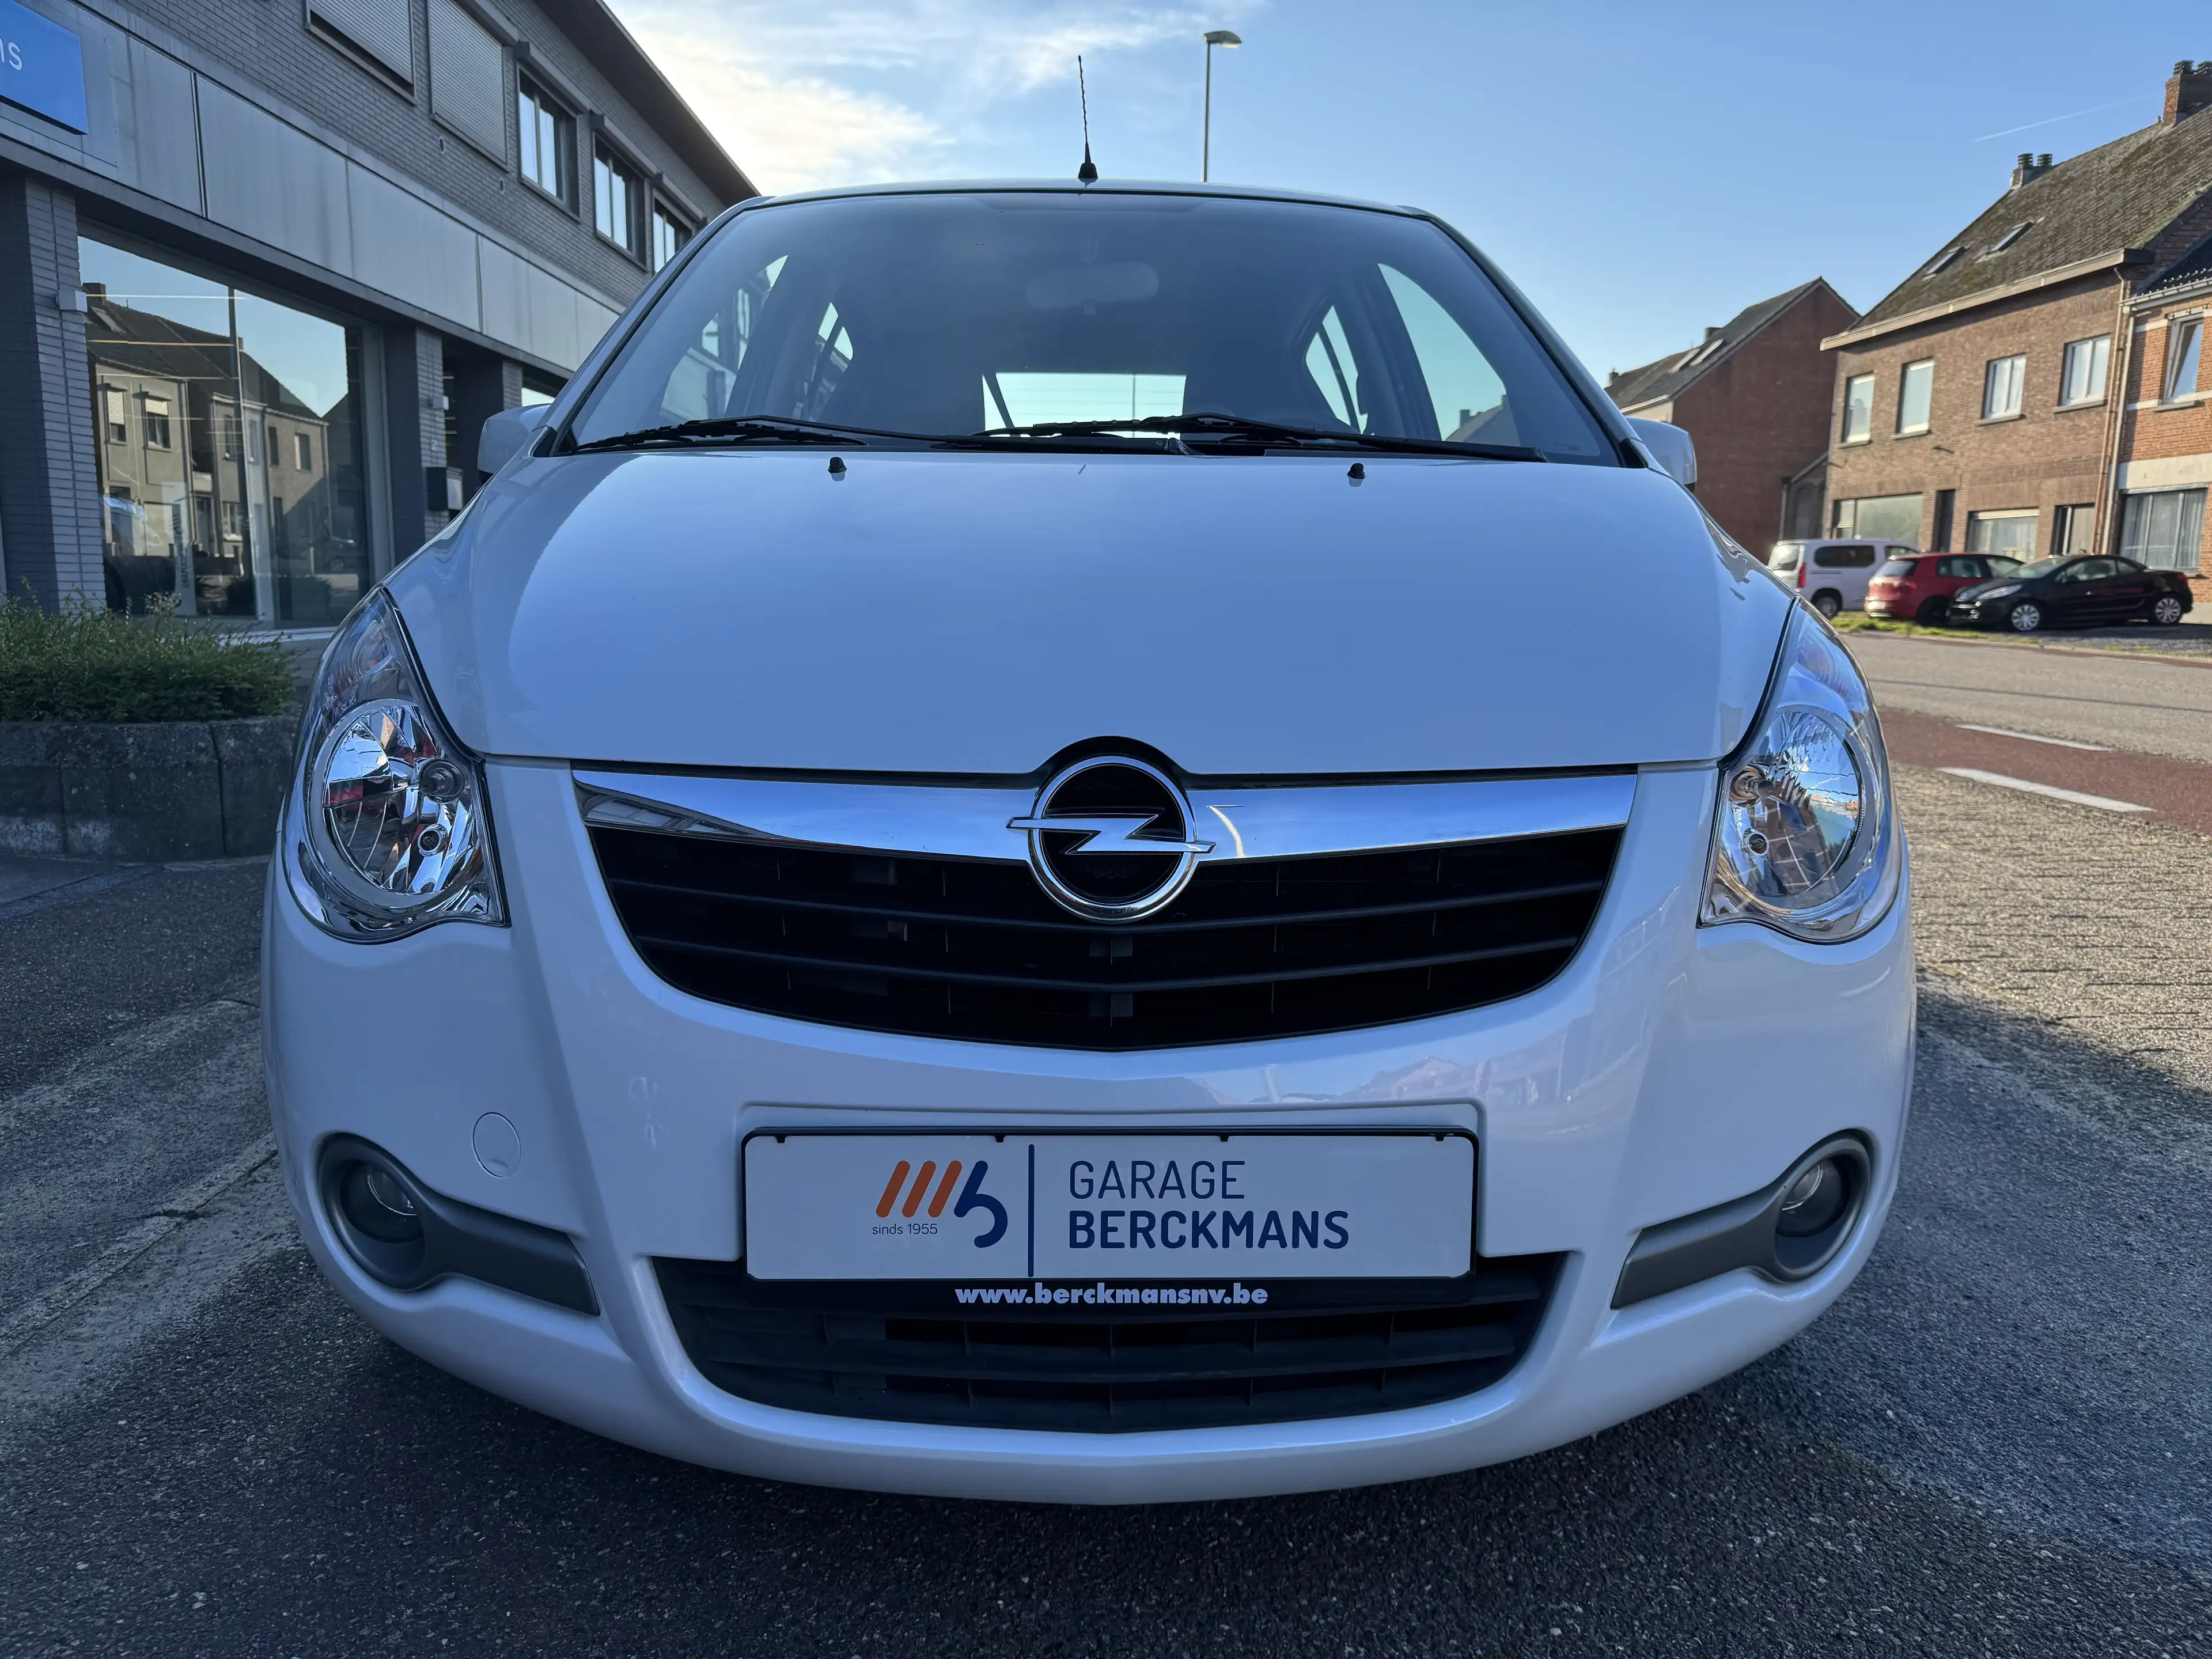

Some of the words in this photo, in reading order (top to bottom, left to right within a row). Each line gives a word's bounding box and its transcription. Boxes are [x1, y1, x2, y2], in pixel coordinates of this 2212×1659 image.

[1070, 1160, 1245, 1199] GARAGE
[872, 1223, 903, 1235] sinds
[907, 1223, 938, 1235] 1955
[1069, 1210, 1349, 1249] BERCKMANS
[955, 1282, 1268, 1304] www.berckmansnv.be
